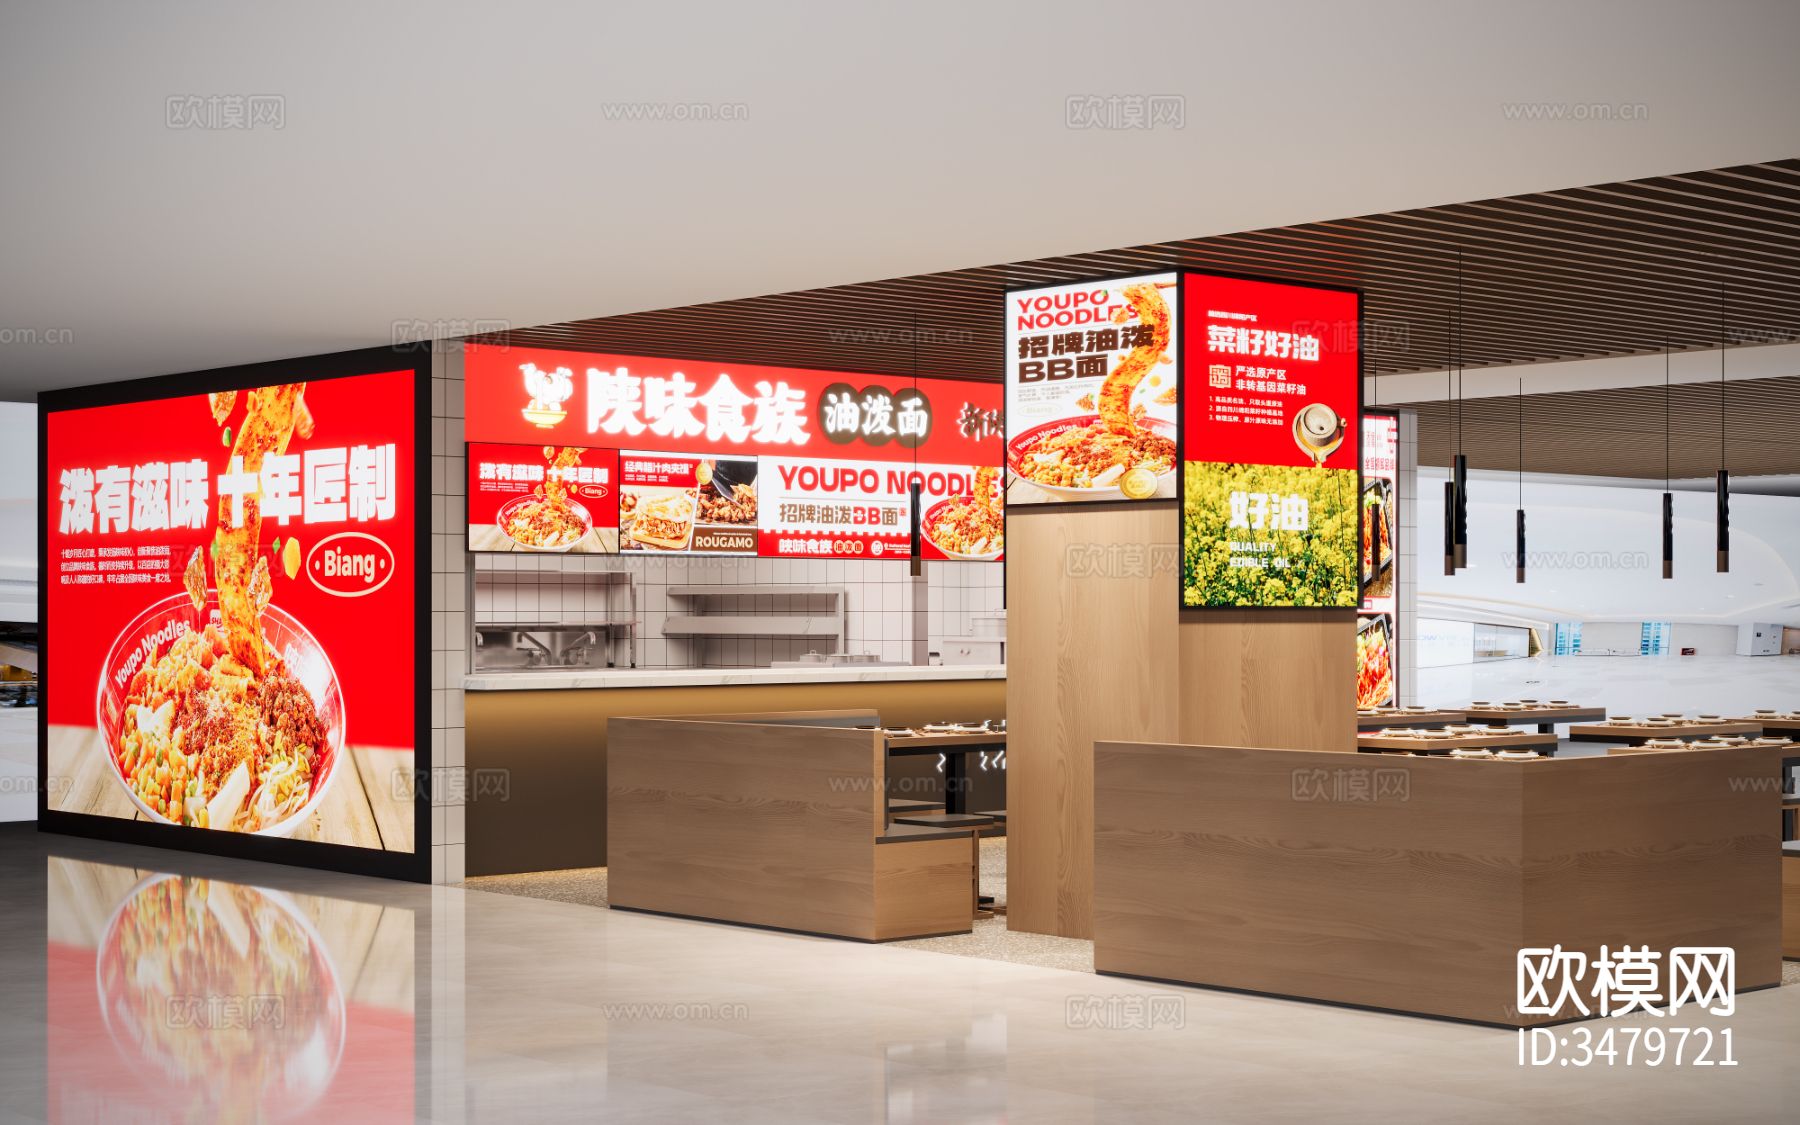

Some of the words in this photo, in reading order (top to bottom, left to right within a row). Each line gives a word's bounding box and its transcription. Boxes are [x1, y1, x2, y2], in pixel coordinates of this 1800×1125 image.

[1017, 289, 1109, 314] YOUPO
[1018, 324, 1156, 360] 招牌油泼
[1207, 324, 1319, 361] 菜籽好油
[1018, 354, 1109, 383] BB面
[1235, 365, 1287, 381] 严选原产区
[1235, 379, 1307, 396] 非转基因菜籽油
[586, 367, 811, 445] 陕味食族
[824, 391, 928, 438] 油泼面
[59, 458, 209, 535] 泼有滋味
[217, 443, 396, 528] 十年匠制
[778, 464, 880, 493] YOUPO
[779, 503, 898, 526] 招牌油泼BB面
[1229, 491, 1309, 531] 好油
[695, 536, 754, 549] ROUGAMO
[324, 545, 376, 584] Biang
[114, 648, 142, 688] Youpo
[141, 619, 191, 652] Noodles
